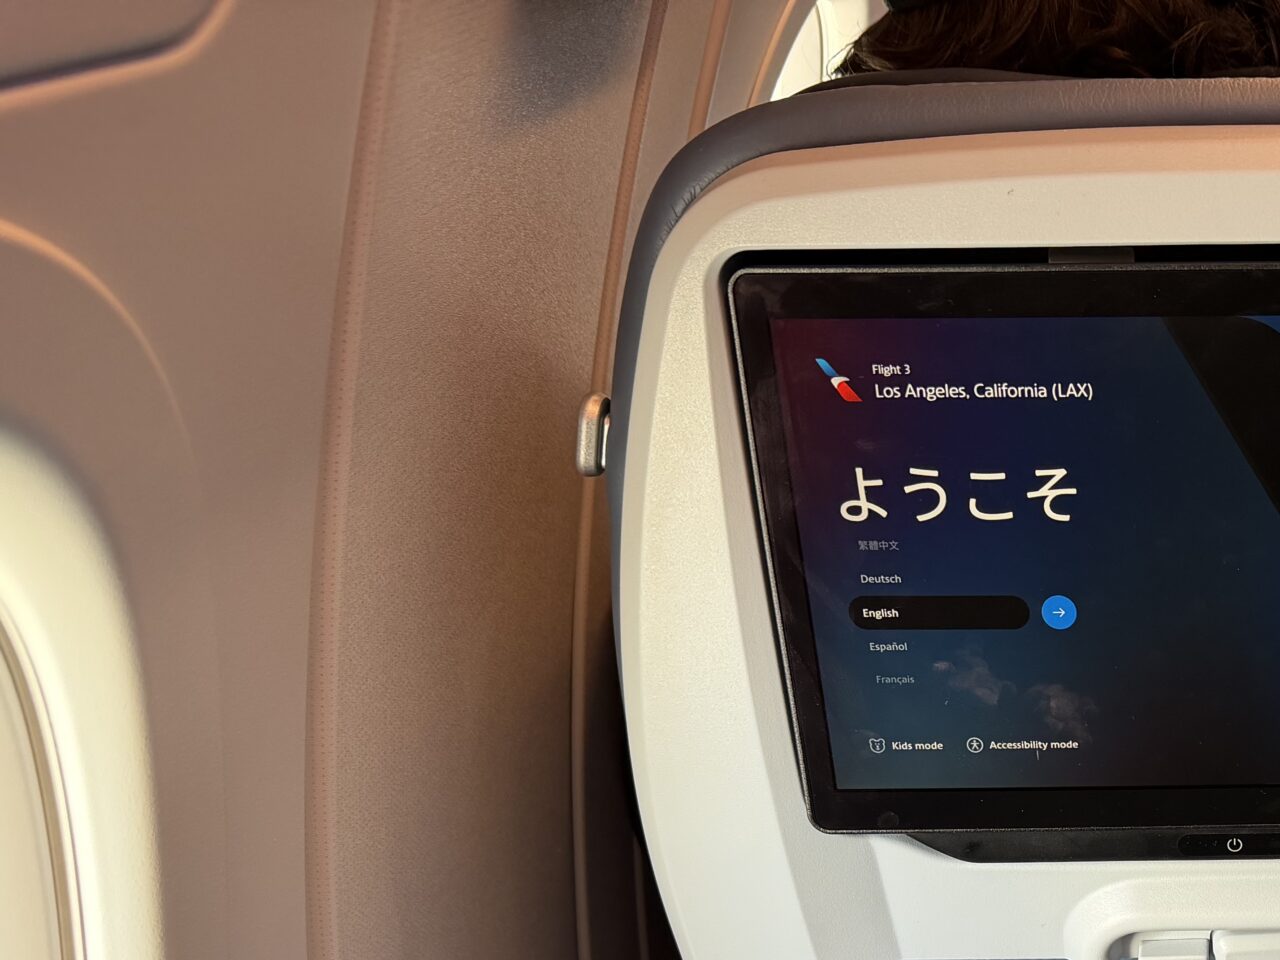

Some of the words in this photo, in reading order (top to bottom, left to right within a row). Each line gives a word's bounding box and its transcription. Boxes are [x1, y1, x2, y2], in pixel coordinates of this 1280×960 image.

[872, 363, 902, 377] Flight
[904, 364, 911, 375] 3
[874, 384, 902, 398] Los
[904, 383, 970, 401] Angeles,
[973, 383, 1047, 398] California
[1051, 383, 1093, 401] (LAX)
[840, 467, 1077, 522] ようこそ
[860, 573, 902, 584] Deutsch
[862, 607, 899, 620] English
[869, 641, 908, 653] Español
[876, 674, 915, 686] Français
[892, 740, 912, 751] Kids
[915, 740, 943, 751] mode
[989, 739, 1048, 752] Accessibility
[1050, 739, 1079, 750] mode
